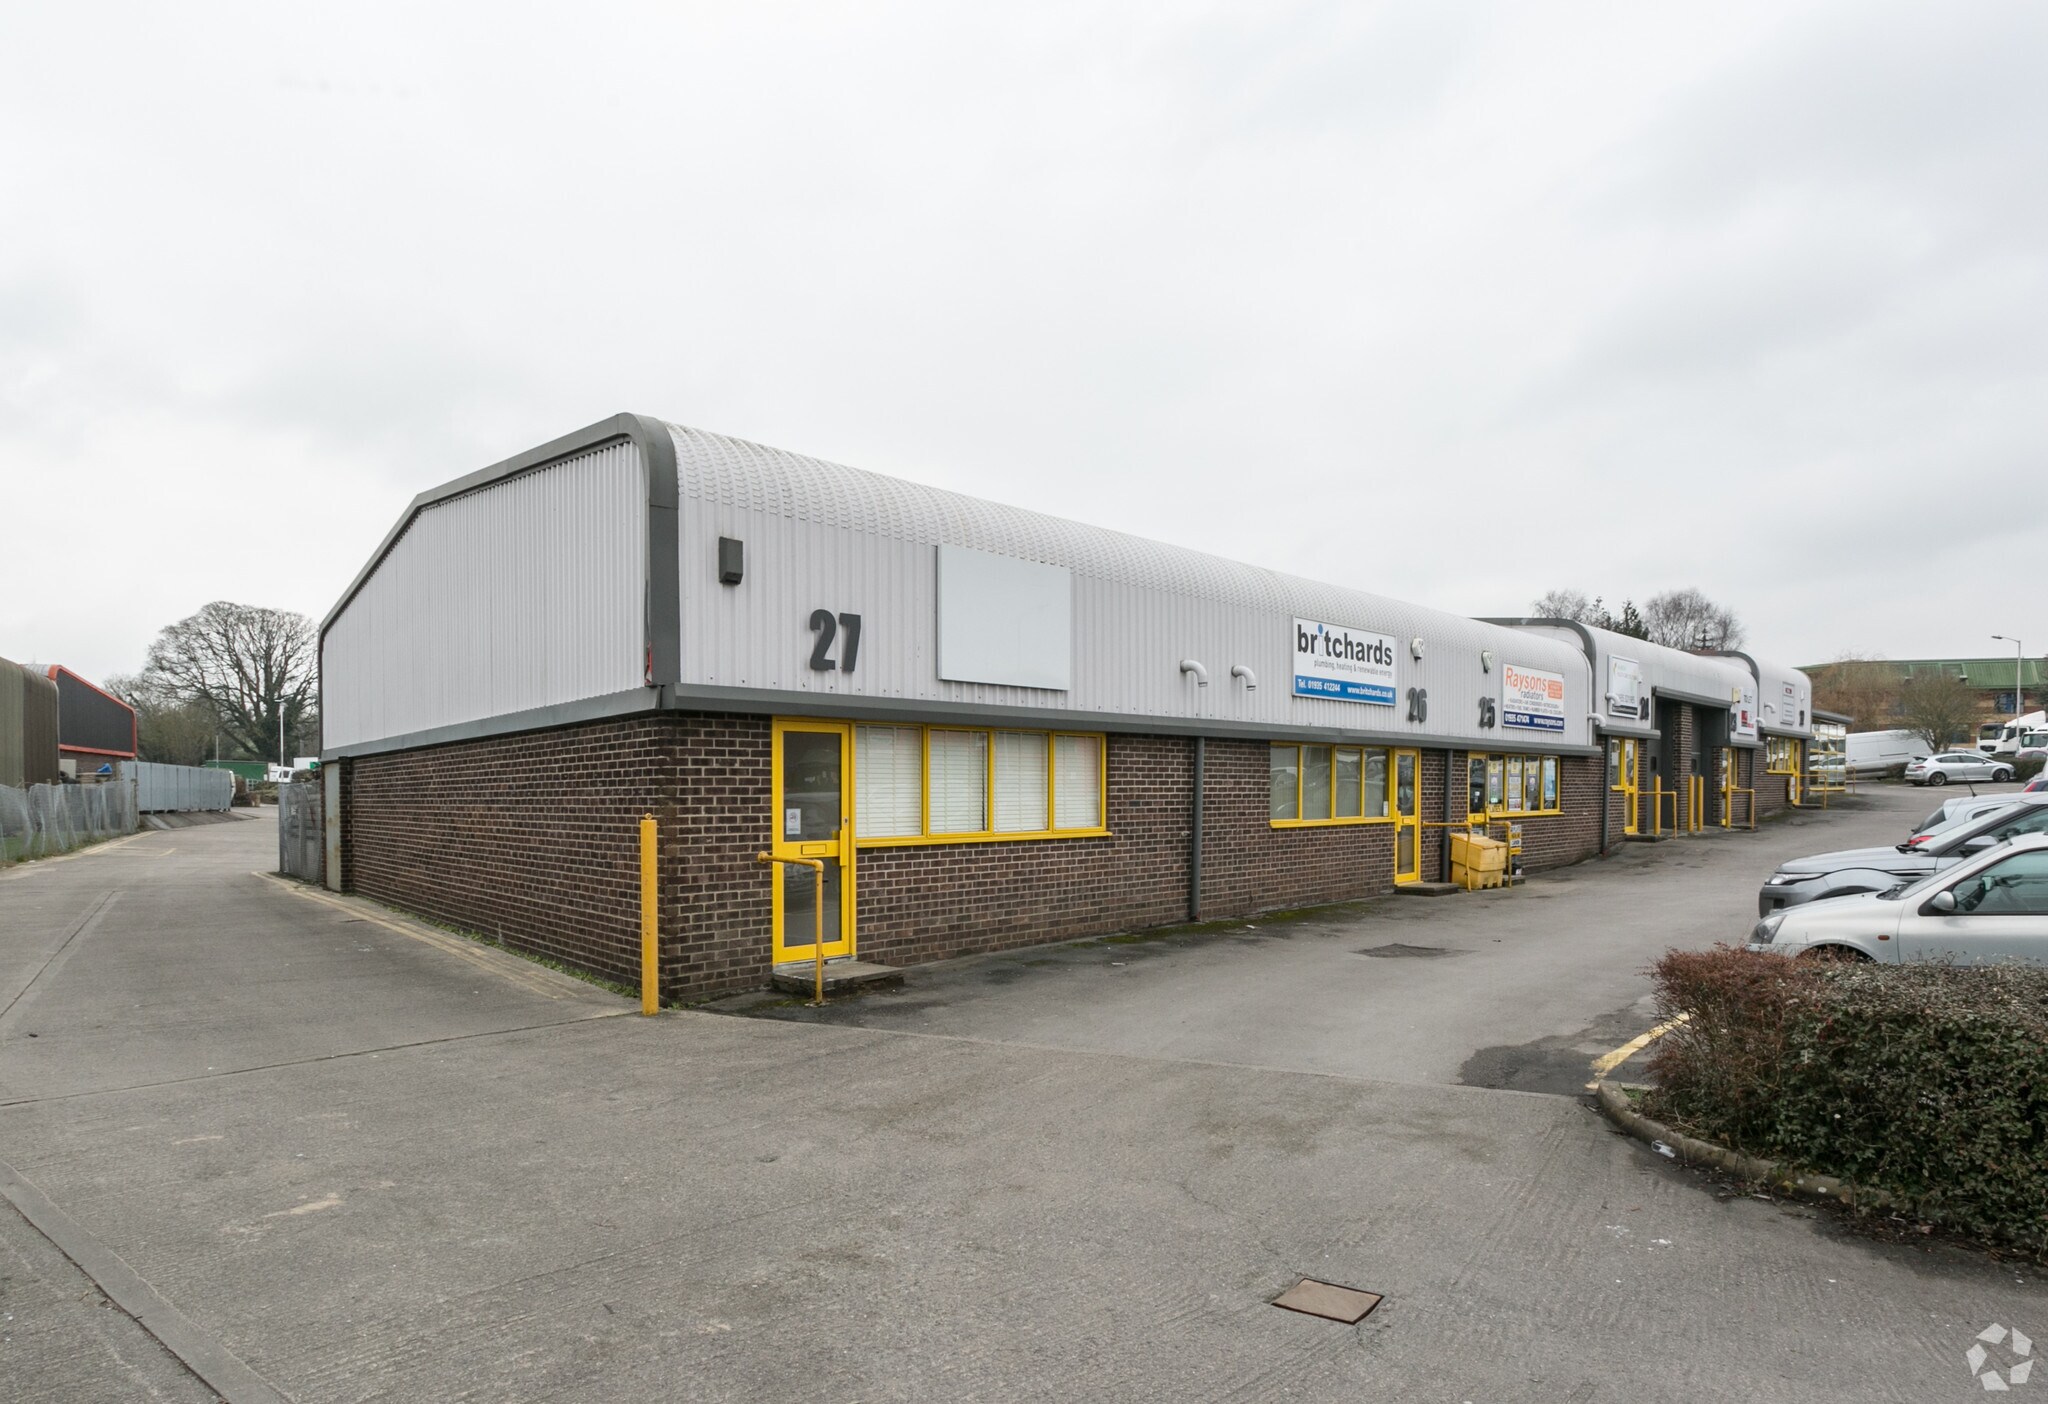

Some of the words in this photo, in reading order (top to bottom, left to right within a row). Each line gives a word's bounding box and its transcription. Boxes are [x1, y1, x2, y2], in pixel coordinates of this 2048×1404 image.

[809, 608, 861, 672] 27
[1297, 623, 1393, 667] britchards
[1505, 667, 1547, 692] Raysons
[1521, 690, 1544, 701] radiators
[1407, 687, 1428, 723] 26
[1479, 696, 1495, 728] 25
